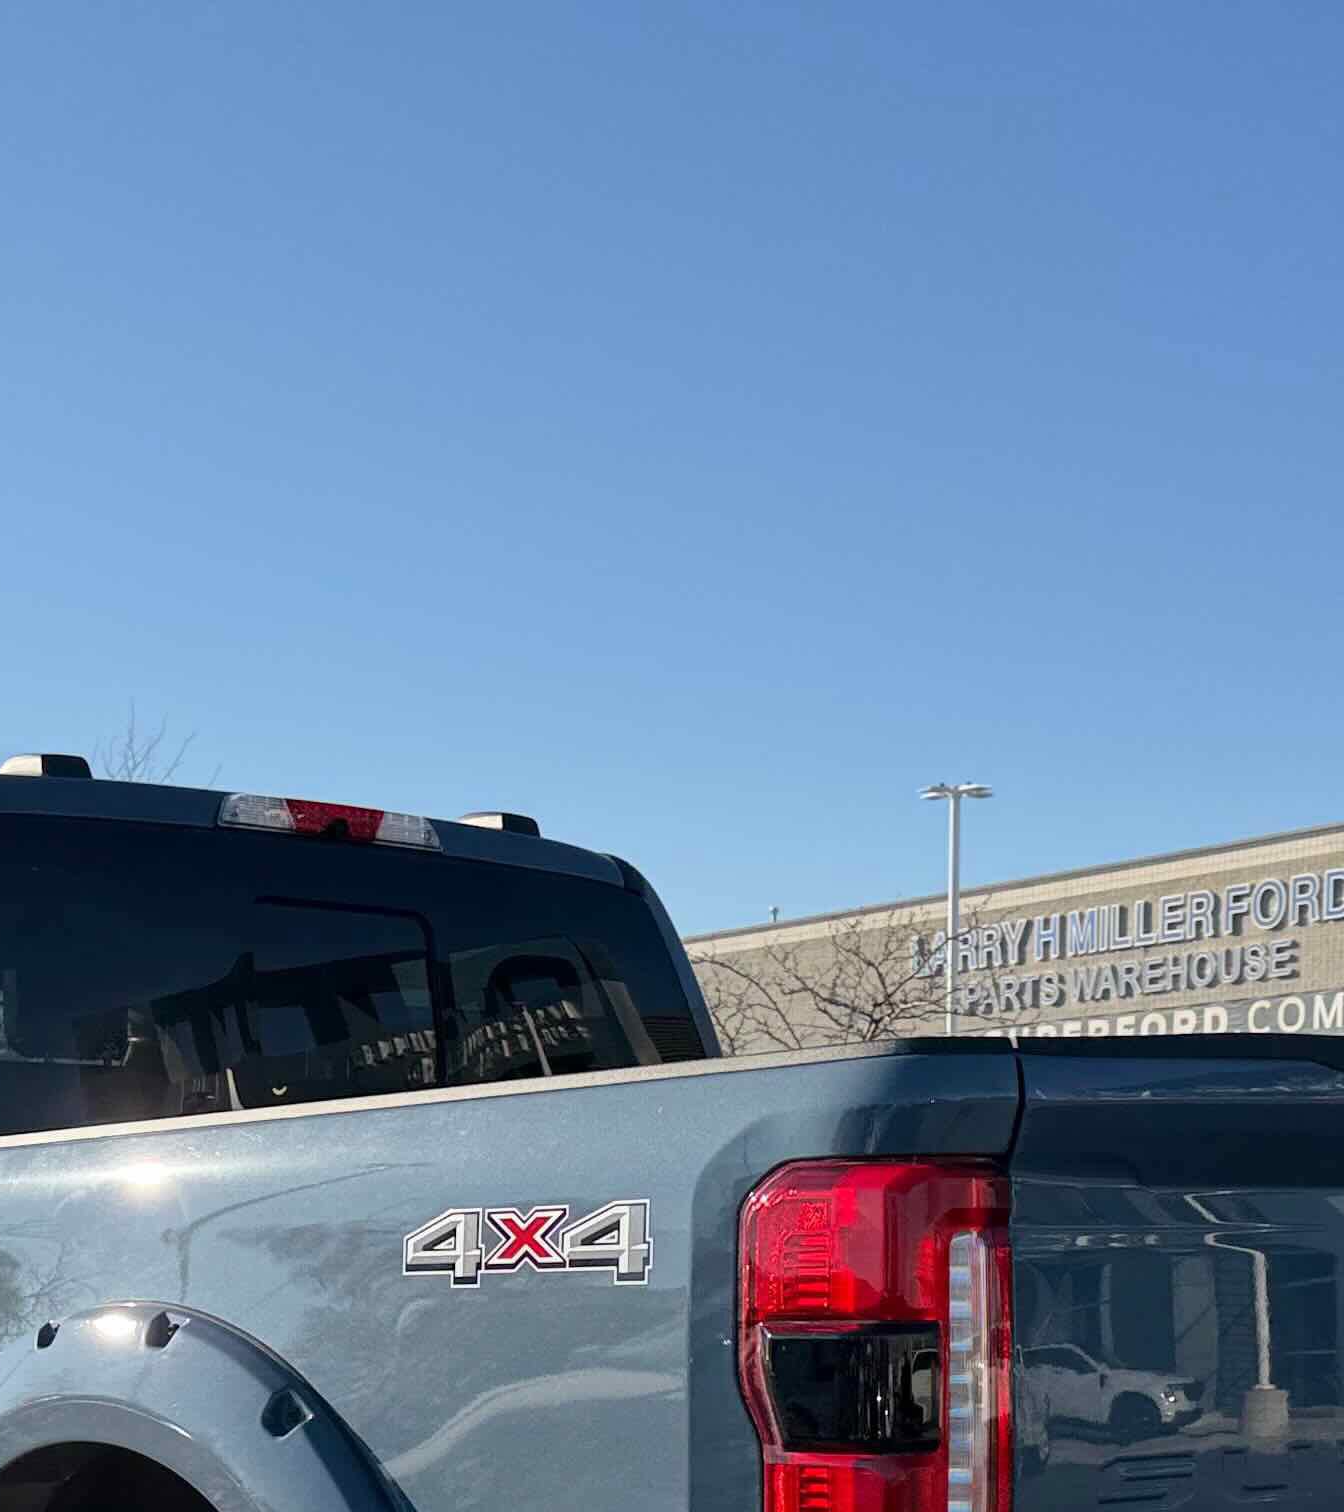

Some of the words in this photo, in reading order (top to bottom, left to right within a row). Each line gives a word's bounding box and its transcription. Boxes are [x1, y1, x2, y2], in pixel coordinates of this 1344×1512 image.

[1033, 912, 1062, 961] H
[1067, 890, 1214, 957] MILLER
[961, 973, 1062, 1015] PARTS
[1071, 940, 1297, 1001] WAREHOUSE
